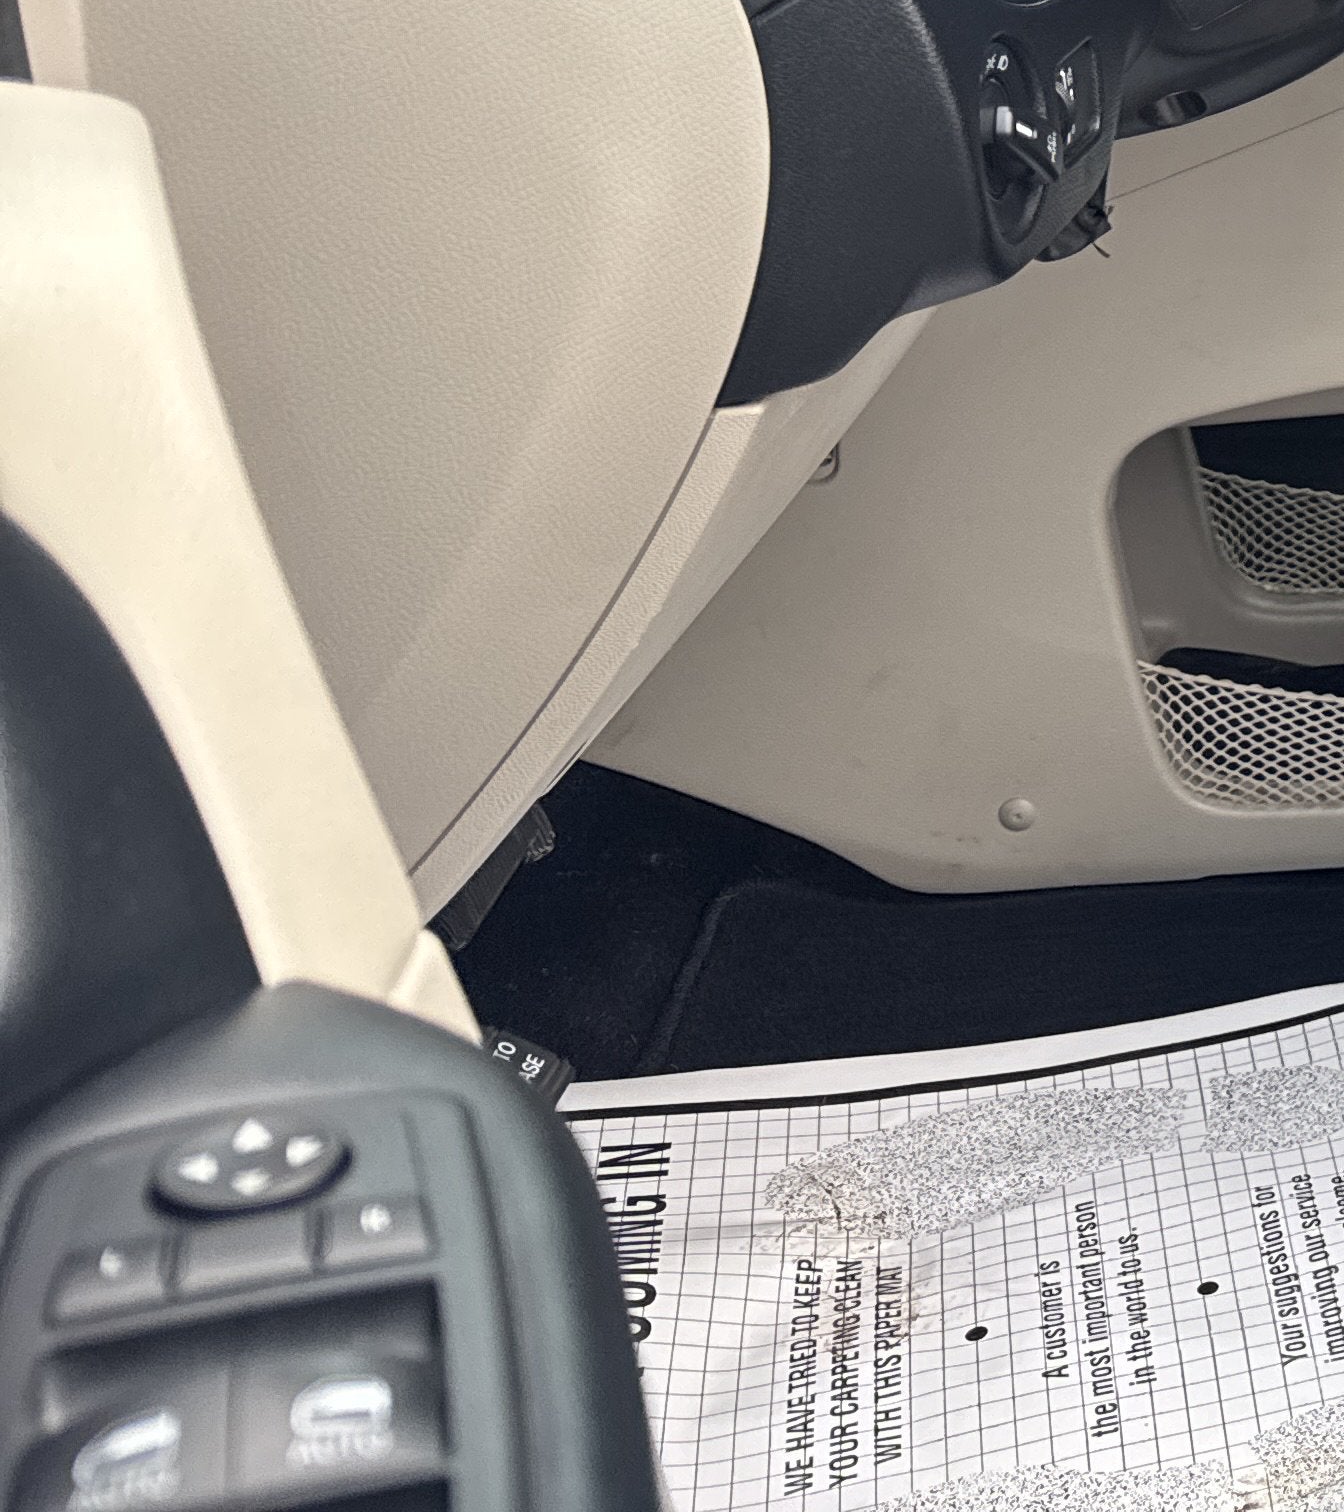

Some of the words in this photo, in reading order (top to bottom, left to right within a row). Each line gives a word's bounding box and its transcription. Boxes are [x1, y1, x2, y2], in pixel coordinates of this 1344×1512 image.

[493, 1041, 516, 1062] TO
[596, 1141, 672, 1180] IN
[1251, 1185, 1276, 1207] for
[1288, 1174, 1322, 1227] service
[1074, 1200, 1104, 1257] person
[1118, 1226, 1140, 1255] us.
[1302, 1233, 1329, 1262] our
[793, 1258, 823, 1310] KEEP
[834, 1259, 863, 1312] CLEAN
[877, 1265, 902, 1295] MAT
[1034, 1260, 1061, 1277] is
[1118, 1258, 1141, 1276] to
[1257, 1209, 1303, 1317] suggestions
[791, 1314, 820, 1336] TO
[875, 1301, 902, 1350] PAPER
[1038, 1281, 1068, 1361] customer
[1076, 1261, 1112, 1344] important
[1117, 1279, 1148, 1326] world
[789, 1338, 818, 1393] TRIED
[830, 1313, 861, 1416] CARPETING
[1125, 1330, 1153, 1361] the
[1278, 1322, 1308, 1366] Your
[875, 1354, 902, 1403] THIS
[1041, 1365, 1069, 1379] A
[1083, 1347, 1115, 1396] most
[1129, 1366, 1156, 1386] in
[785, 1394, 816, 1450] HAVE
[874, 1407, 902, 1464] WITH
[1090, 1402, 1120, 1437] the
[828, 1416, 859, 1488] YOUR
[784, 1457, 814, 1495] WE
